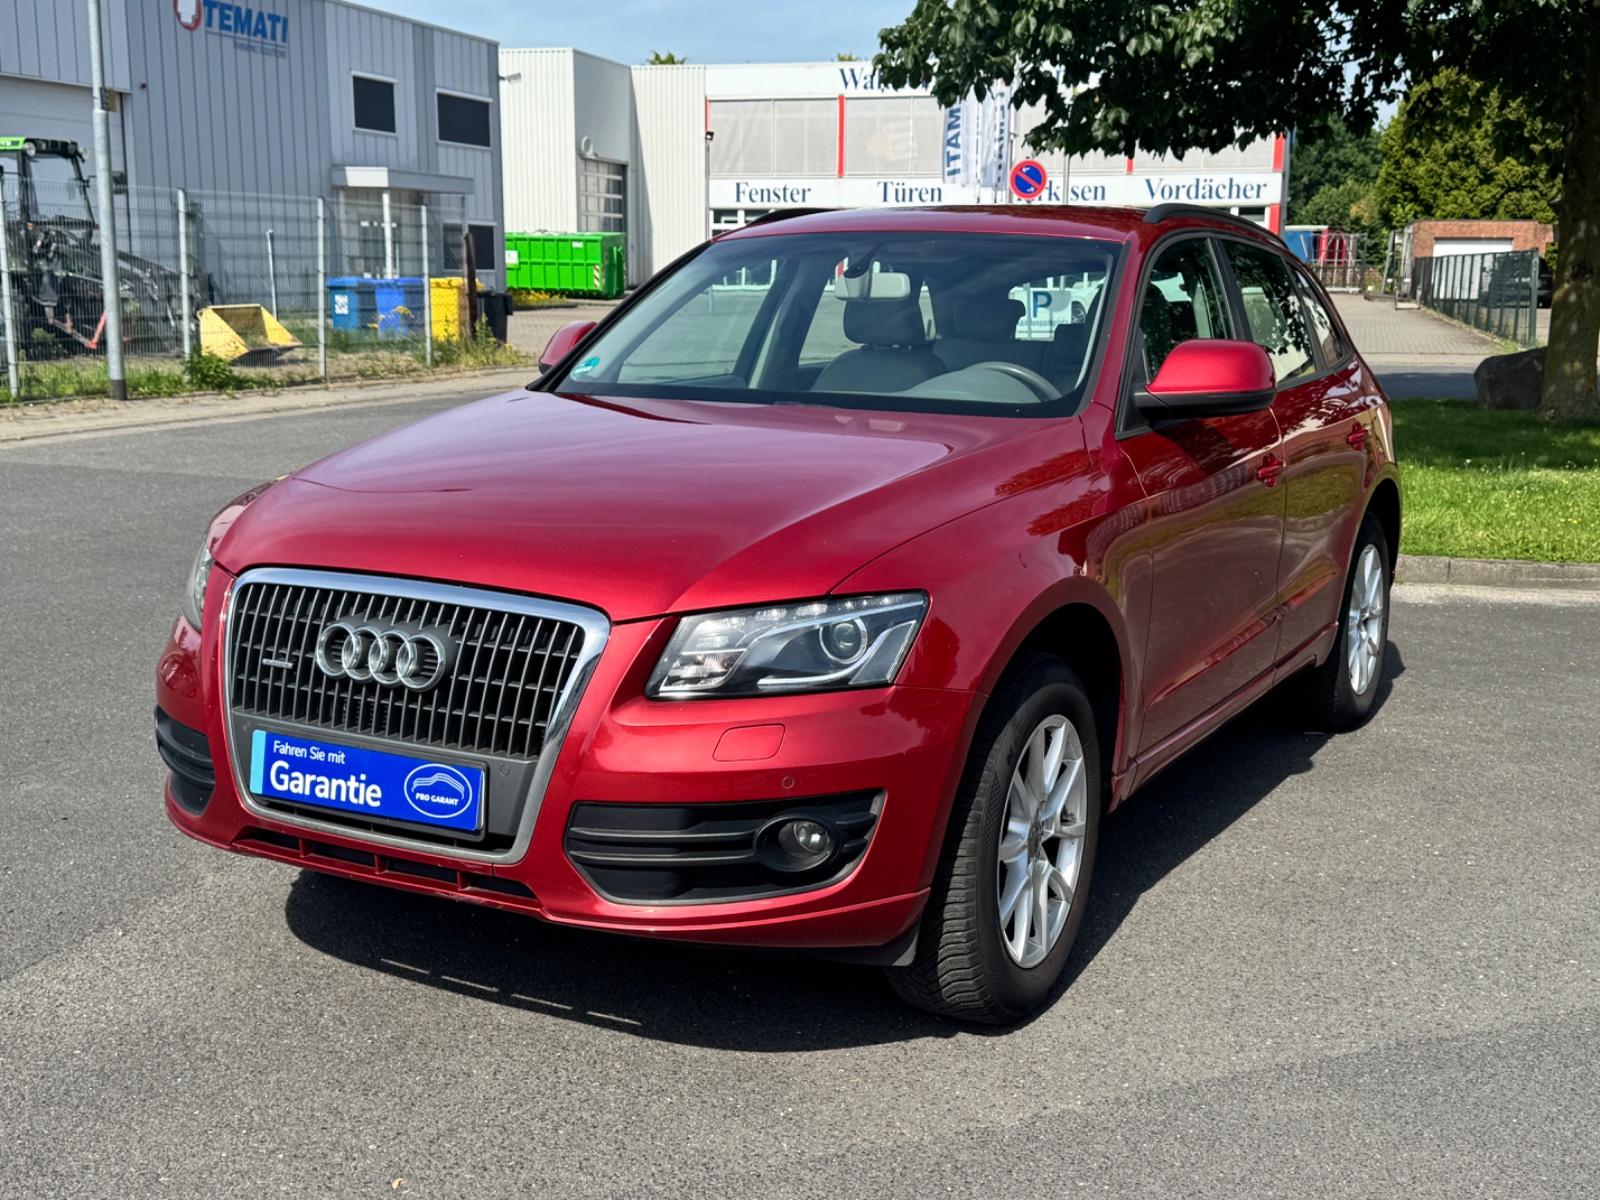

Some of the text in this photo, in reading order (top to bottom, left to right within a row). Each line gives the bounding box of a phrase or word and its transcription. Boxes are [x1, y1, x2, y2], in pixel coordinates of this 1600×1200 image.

[203, 0, 288, 43] TEMATI
[735, 182, 811, 203] Fenster
[877, 182, 942, 203] Türen
[1145, 178, 1267, 201] Vordächer
[1032, 291, 1053, 319] P
[273, 740, 346, 765] Fahren Sie mit
[270, 760, 382, 807] Garantie
[415, 792, 459, 806] PRO GARANT
